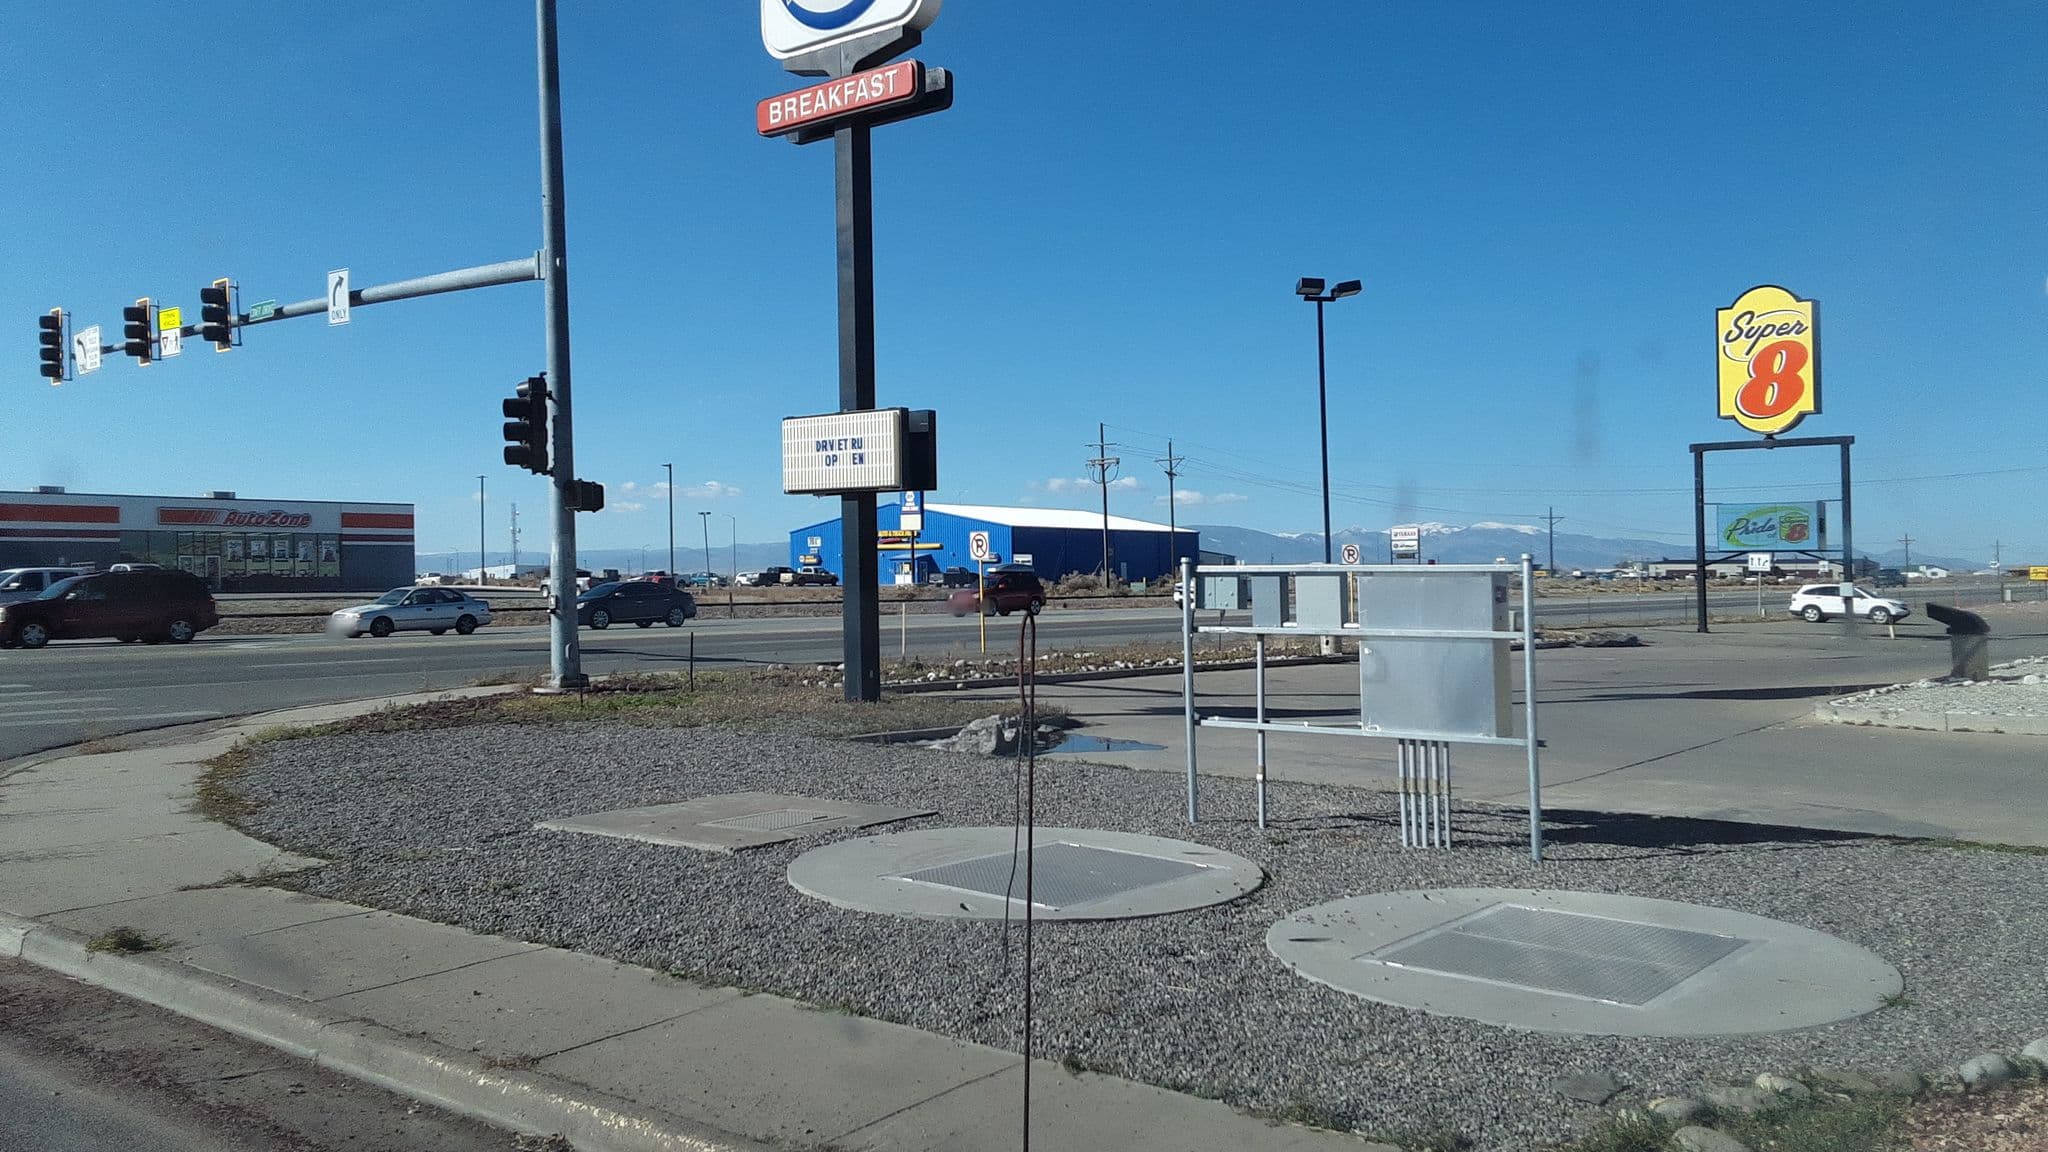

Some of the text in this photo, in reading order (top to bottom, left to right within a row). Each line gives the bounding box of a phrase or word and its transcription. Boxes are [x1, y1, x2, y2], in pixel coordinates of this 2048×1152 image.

[768, 69, 898, 125] BREAKFAST
[331, 309, 346, 321] ONLY
[1724, 310, 1808, 356] Super
[1735, 339, 1809, 419] 8
[223, 511, 310, 526] AutoZone
[1726, 517, 1777, 541] Pride
